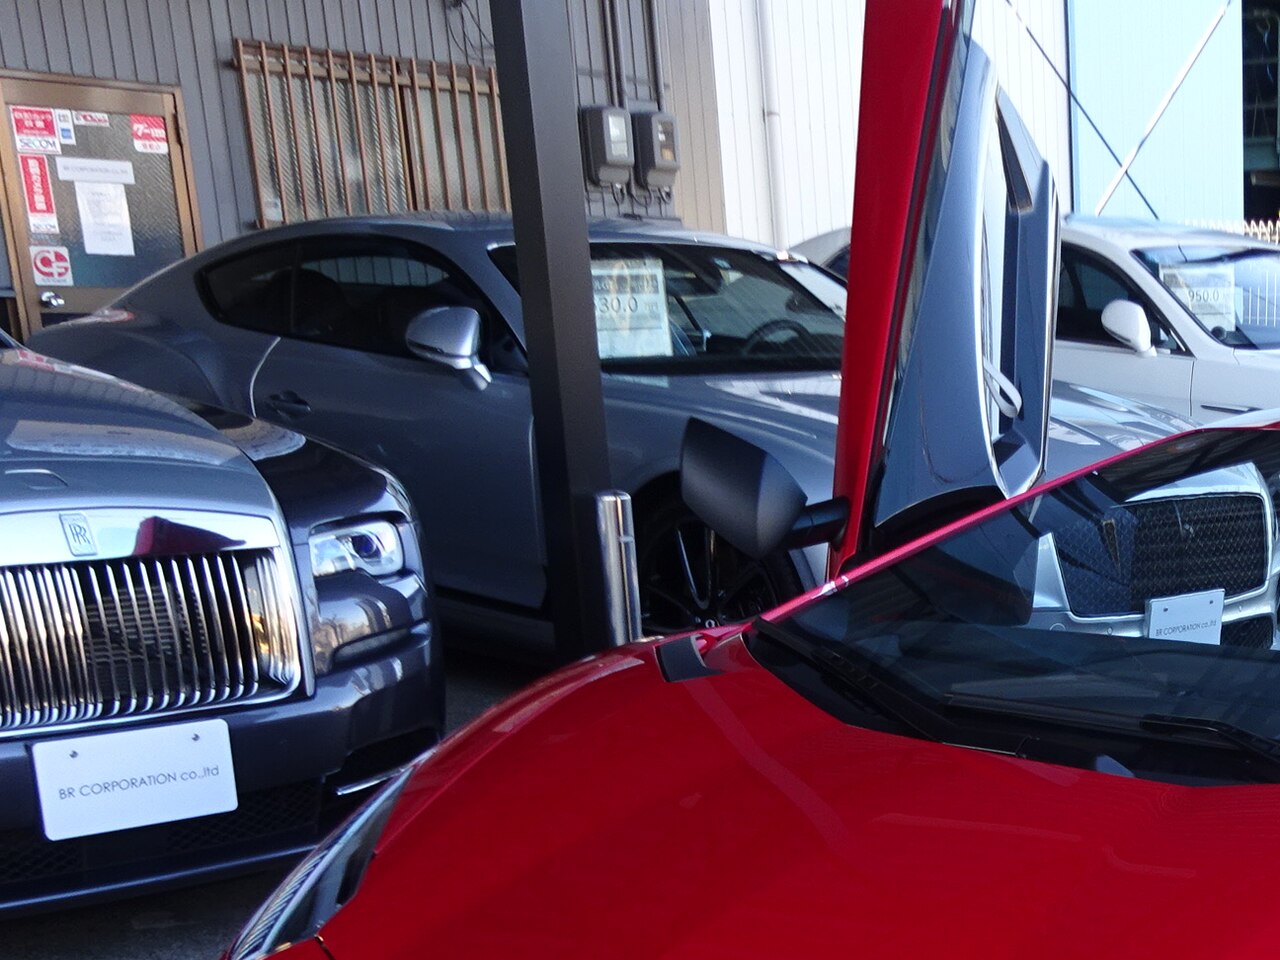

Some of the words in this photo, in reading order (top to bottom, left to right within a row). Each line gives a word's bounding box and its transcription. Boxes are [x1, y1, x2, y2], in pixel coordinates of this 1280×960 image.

[1163, 623, 1200, 636] CORPORATION
[58, 787, 76, 800] BR
[79, 771, 177, 797] CORPORATION
[180, 764, 220, 782] co.,ltd
